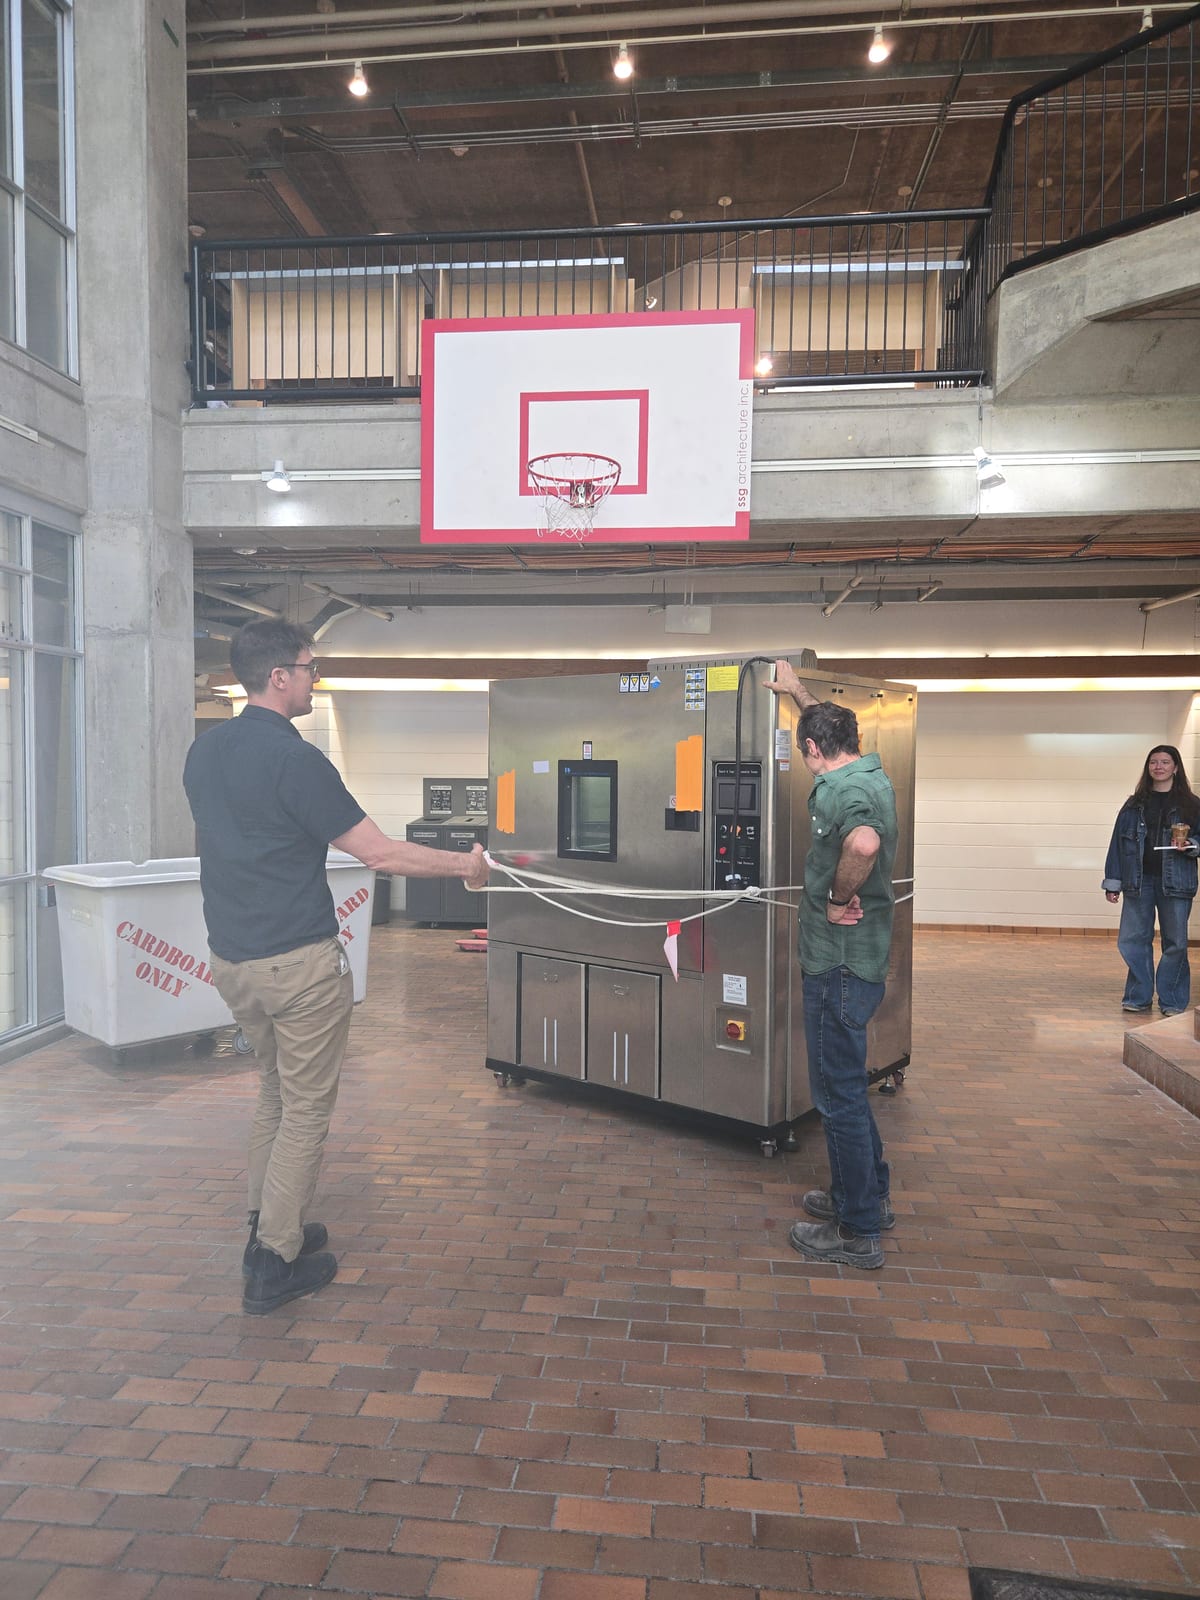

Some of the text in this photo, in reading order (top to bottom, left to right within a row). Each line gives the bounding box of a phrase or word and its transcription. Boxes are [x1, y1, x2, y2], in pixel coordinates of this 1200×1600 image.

[737, 383, 749, 507] ssg architecture inc.
[136, 961, 191, 998] ONLY
